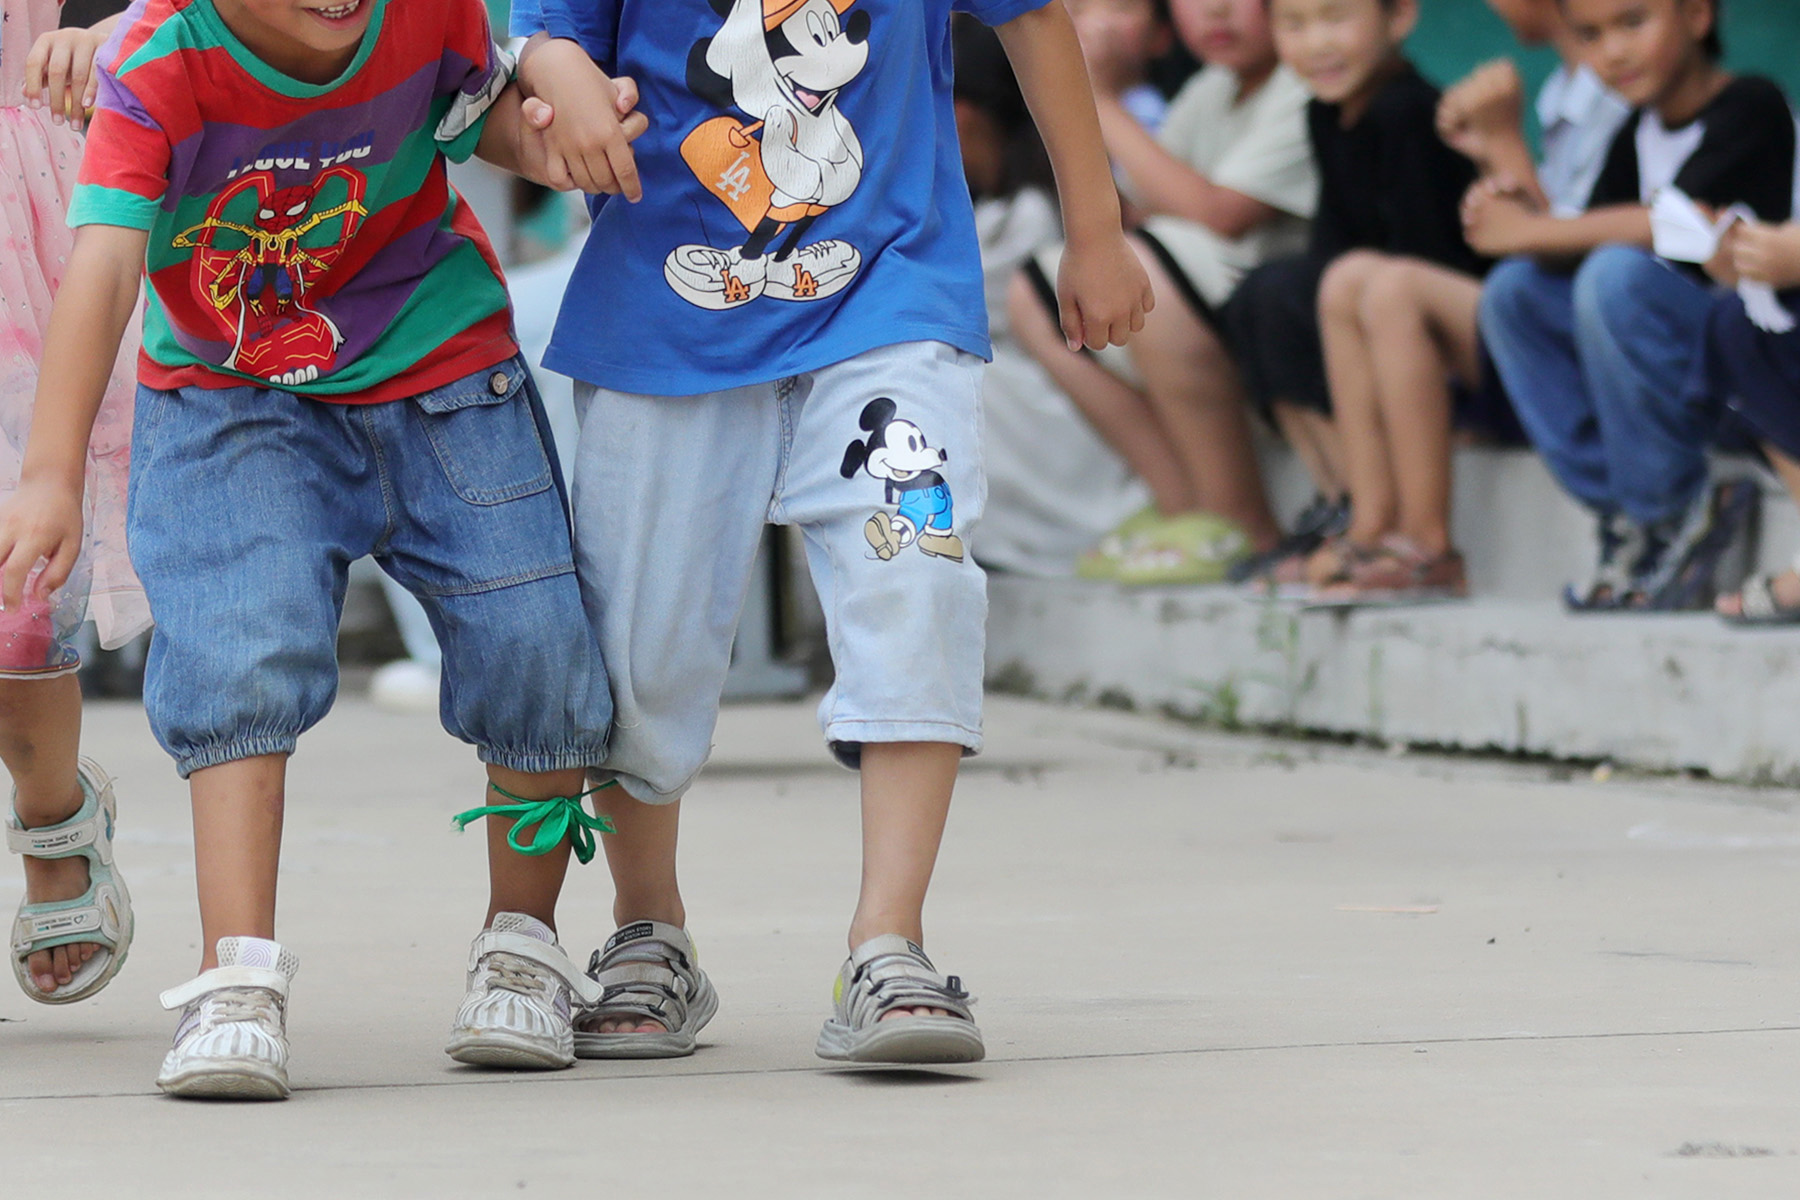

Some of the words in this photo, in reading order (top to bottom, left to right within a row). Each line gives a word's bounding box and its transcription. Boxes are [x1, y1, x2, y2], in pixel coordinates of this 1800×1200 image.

[715, 151, 752, 202] LA
[720, 268, 751, 304] LA
[792, 262, 820, 298] LA
